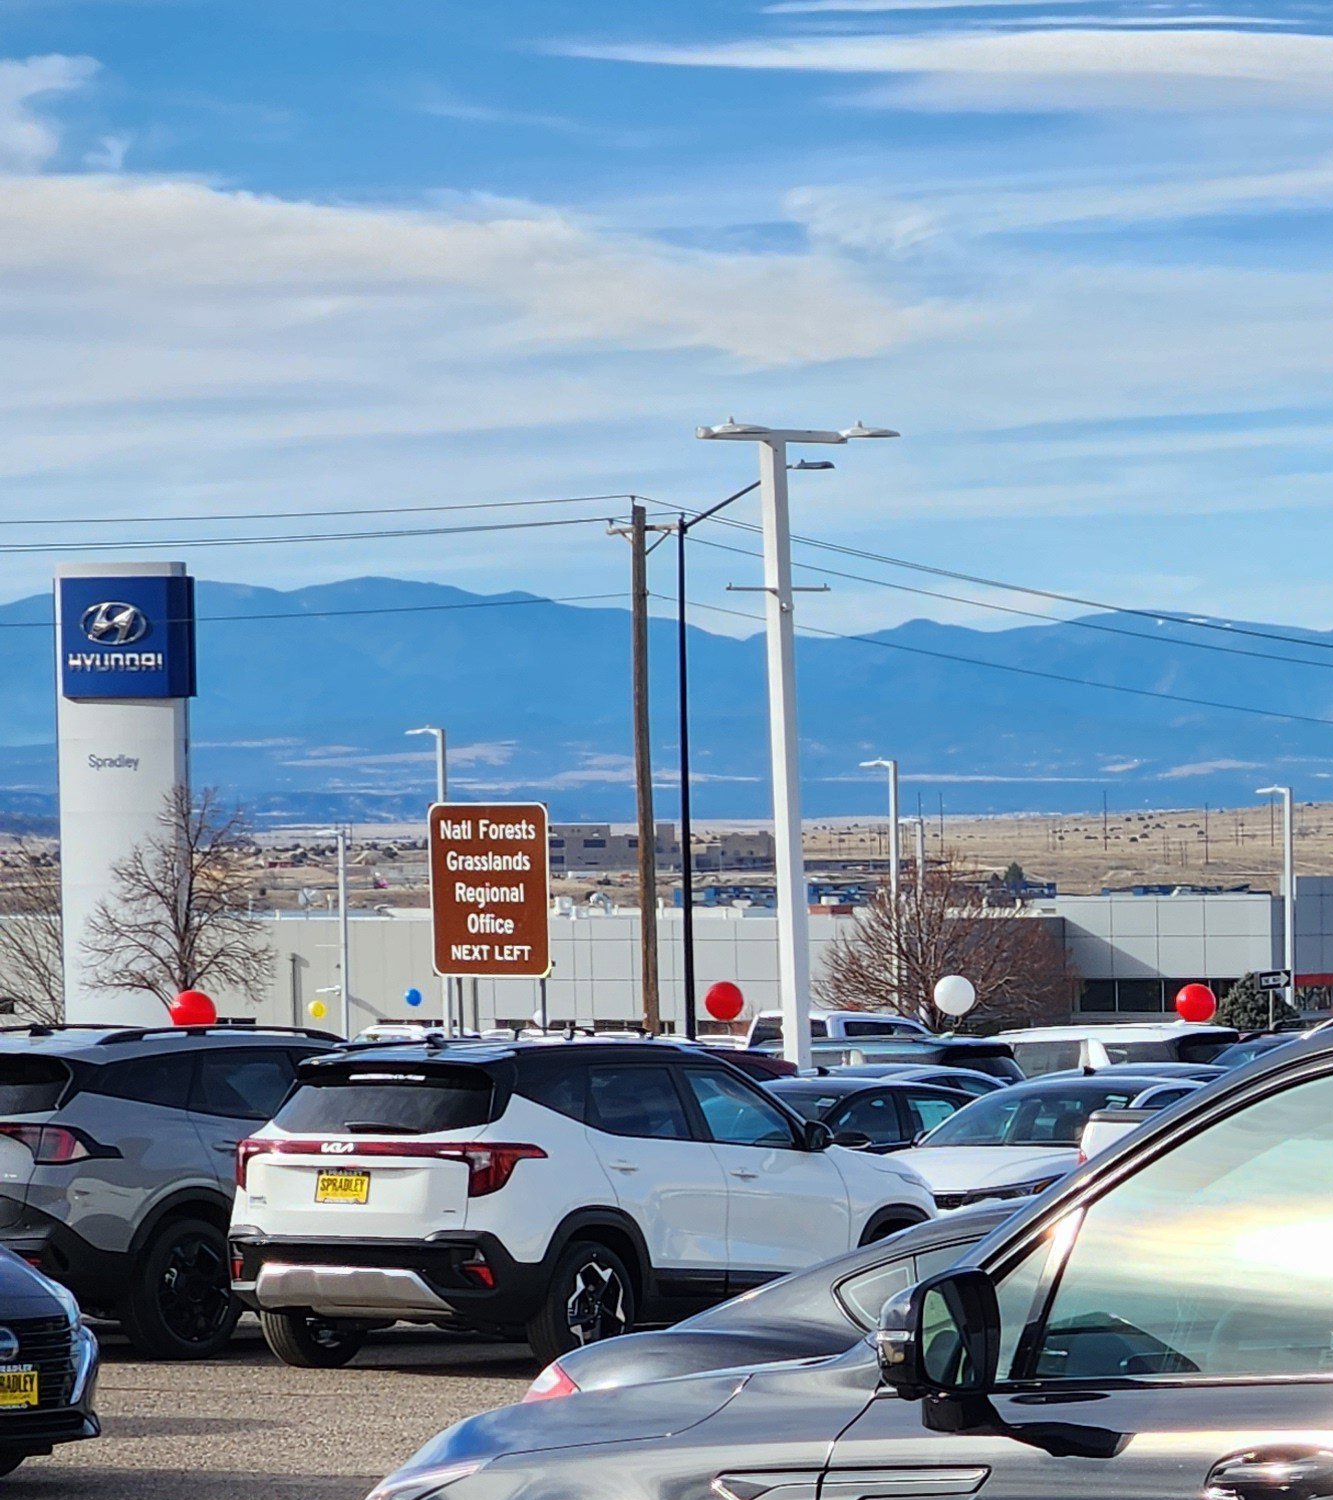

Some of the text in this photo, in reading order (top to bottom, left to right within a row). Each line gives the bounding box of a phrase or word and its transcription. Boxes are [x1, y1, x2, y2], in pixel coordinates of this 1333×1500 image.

[68, 653, 163, 672] HYUNDAI
[88, 754, 139, 771] Spradley
[439, 819, 536, 840] Natl Forests
[446, 851, 531, 871] Grasslands
[455, 882, 525, 909] Regional
[467, 913, 515, 934] Office
[451, 945, 532, 961] NEXT LEFT
[320, 1178, 365, 1192] SPRADLEY
